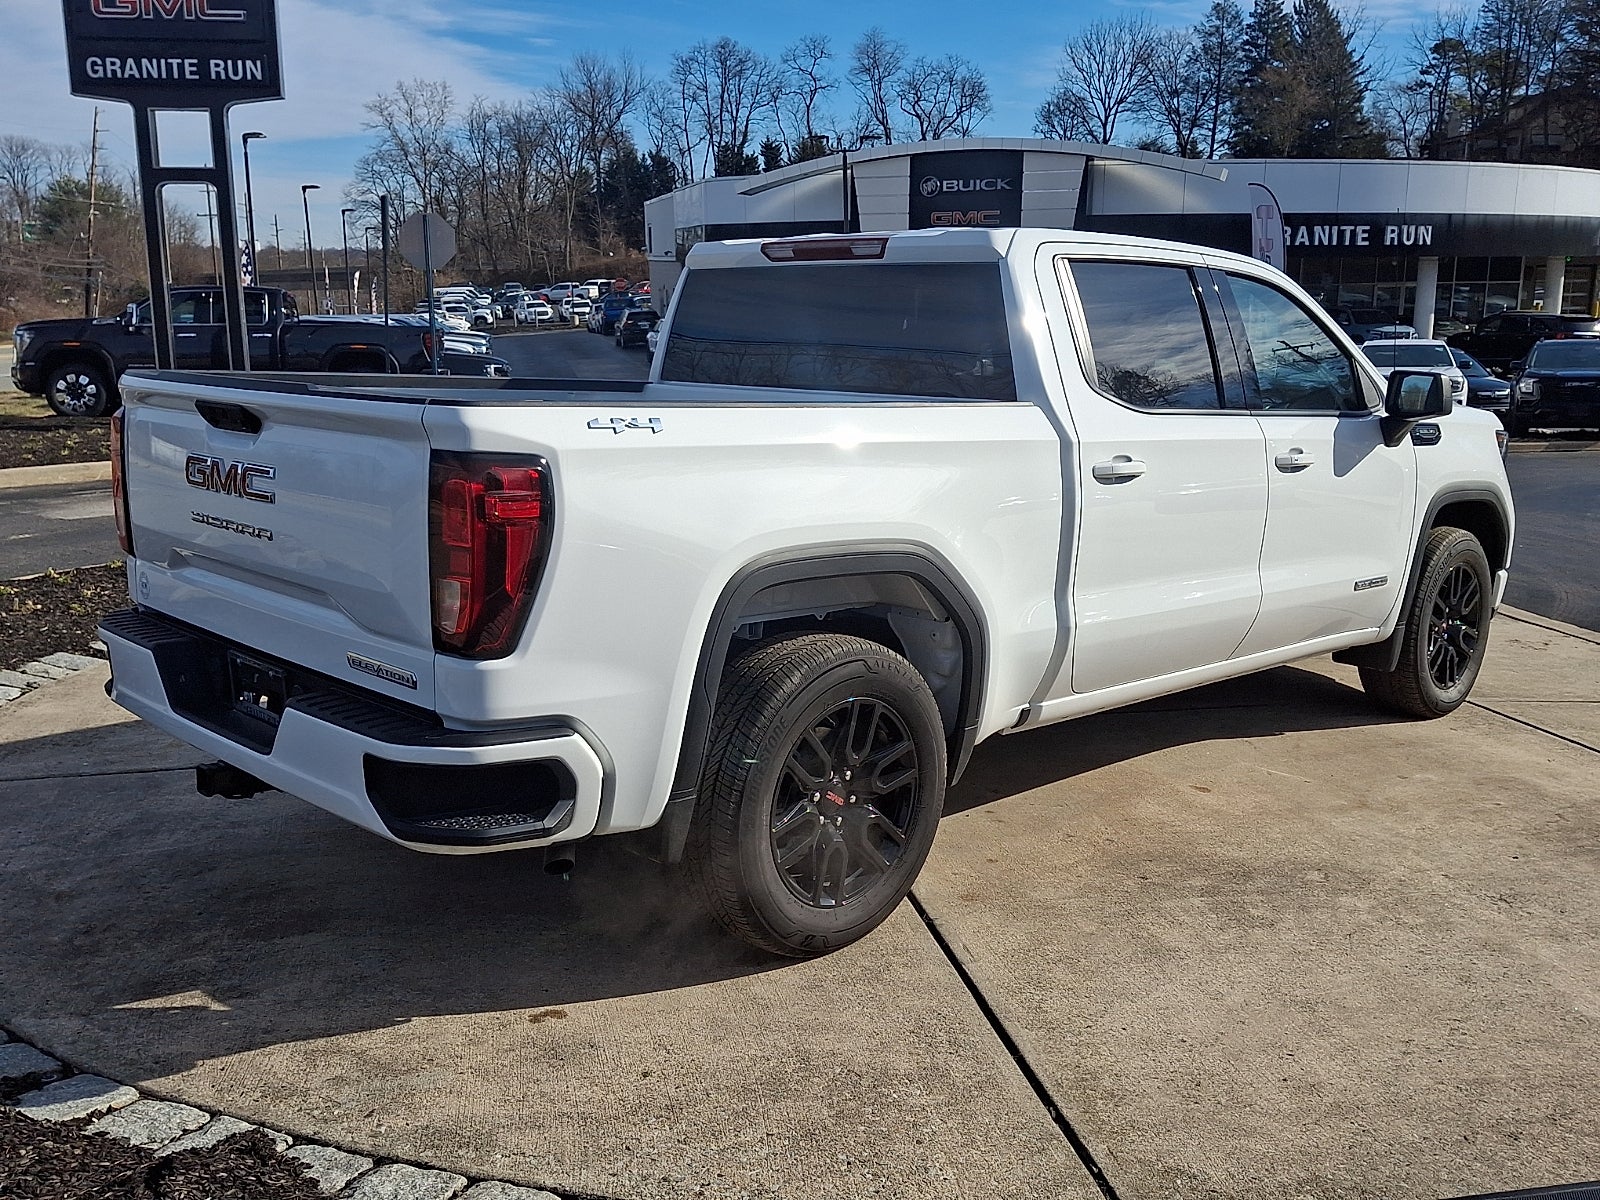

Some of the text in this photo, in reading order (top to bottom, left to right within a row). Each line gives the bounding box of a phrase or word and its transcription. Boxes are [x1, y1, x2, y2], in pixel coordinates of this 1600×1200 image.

[91, 0, 247, 21] GMC
[85, 56, 263, 81] GRANITE RUN
[942, 178, 1013, 192] BUICK
[930, 209, 1001, 226] GMC
[1284, 224, 1433, 246] RANITE RUN
[185, 451, 277, 505] GMC
[190, 510, 274, 542] SIERRA
[350, 658, 412, 684] ELEVATION
